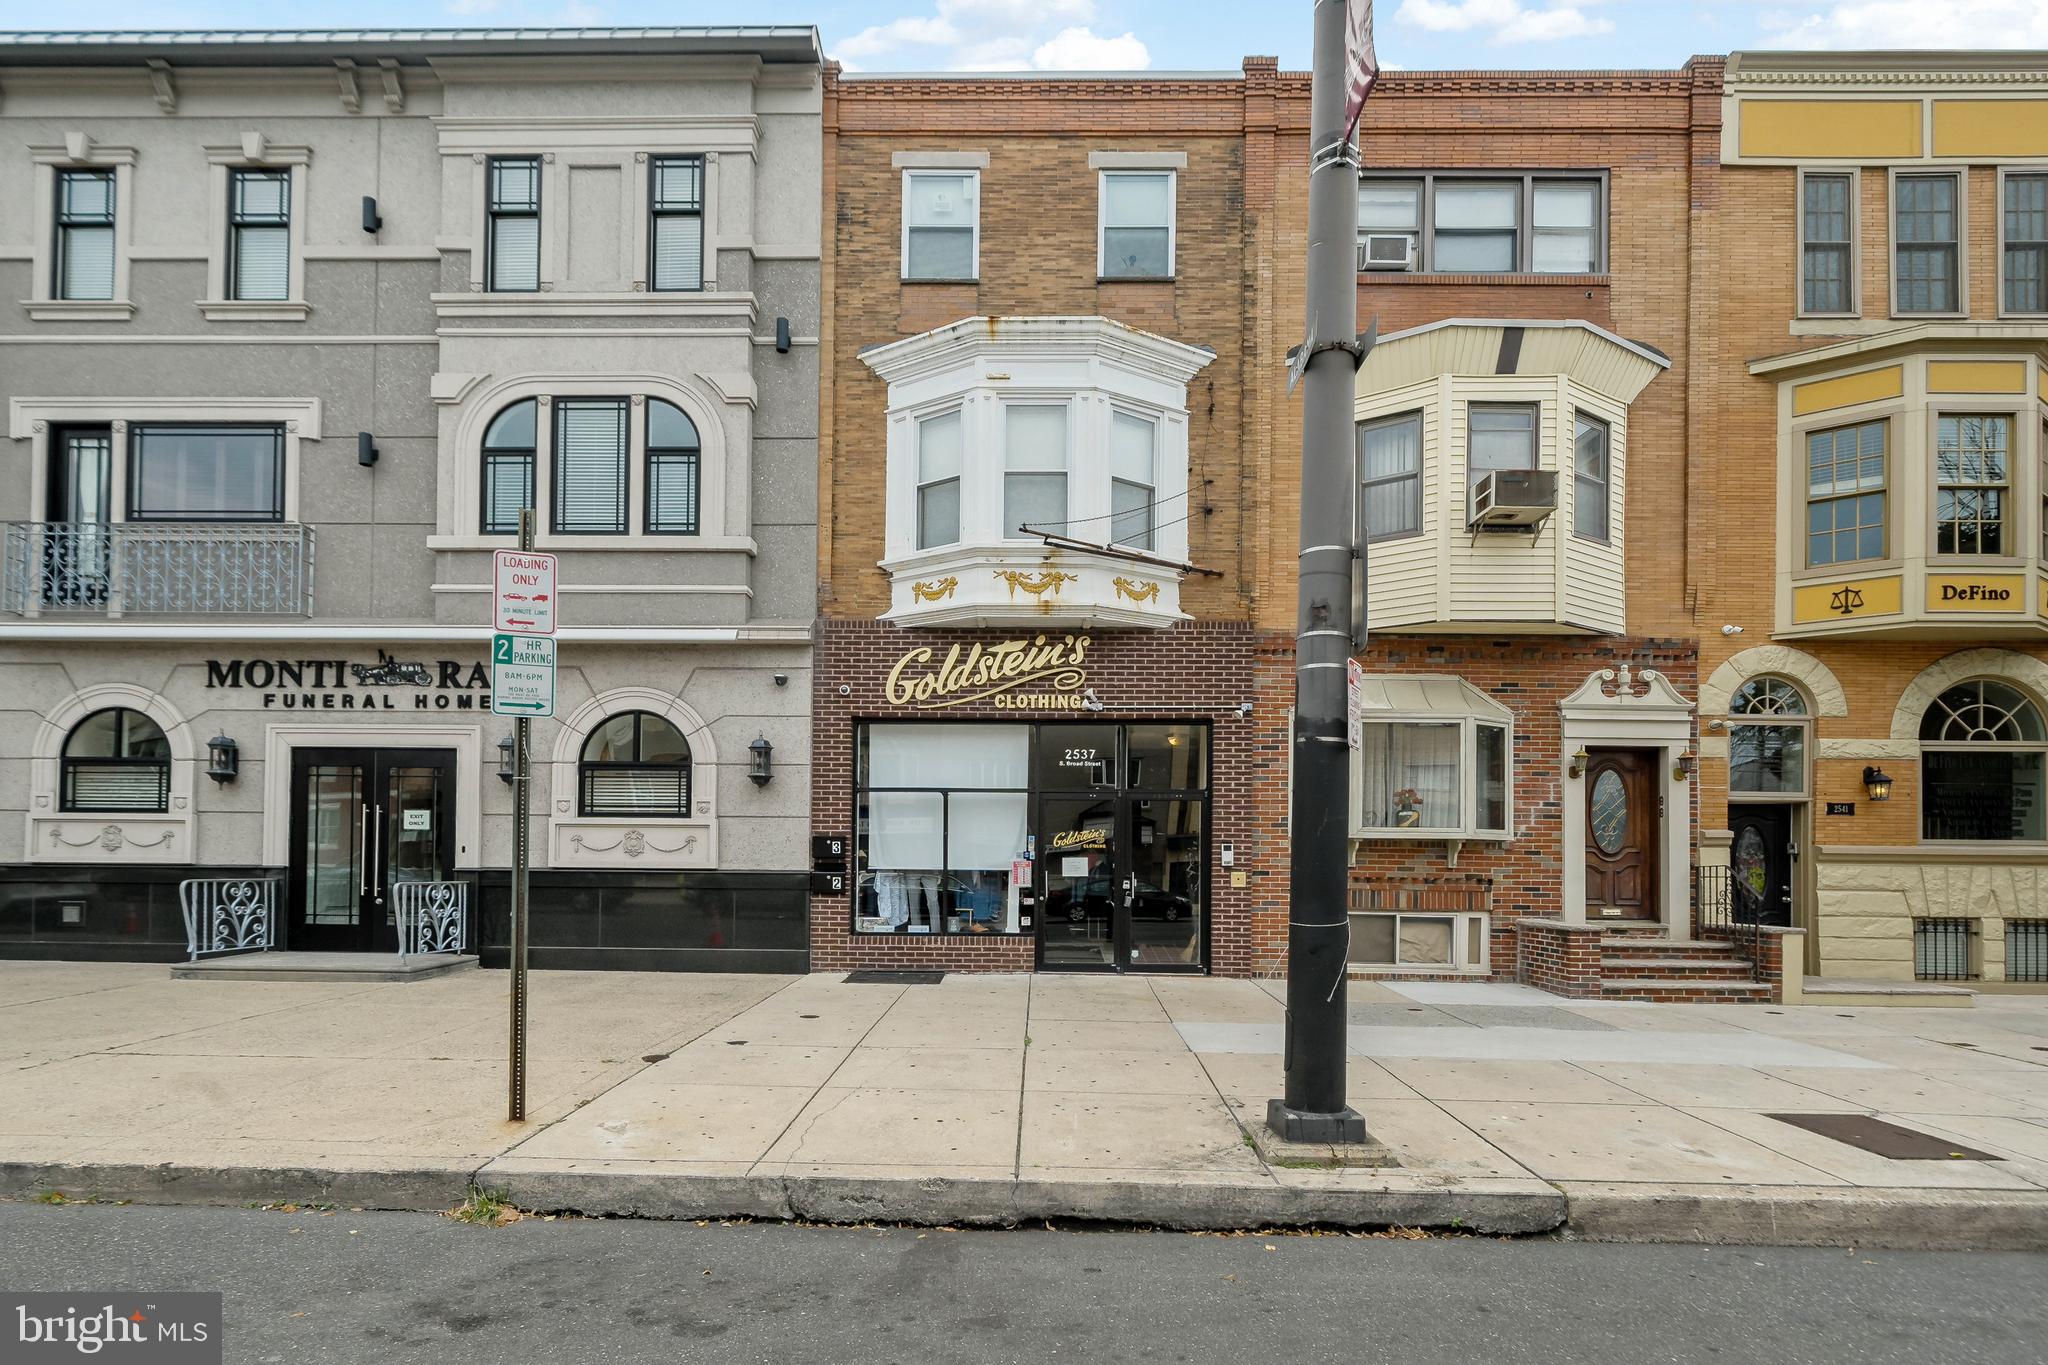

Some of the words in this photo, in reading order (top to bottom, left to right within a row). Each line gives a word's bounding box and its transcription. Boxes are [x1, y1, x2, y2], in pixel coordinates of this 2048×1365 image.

[503, 556, 549, 571] LOADING
[512, 574, 539, 586] ONLY
[1941, 584, 2010, 601] DeFino
[512, 607, 532, 615] MINUTE
[497, 639, 509, 660] 2
[526, 640, 542, 651] HR
[513, 652, 552, 665] PARKING
[205, 659, 348, 688] MONTI
[435, 659, 491, 689] RA
[885, 633, 1091, 706] Goldstein's
[263, 693, 395, 709] FUNERAL
[414, 693, 491, 710] HOME
[994, 693, 1082, 709] CLOTHING
[1064, 748, 1096, 760] 2537
[1834, 804, 1848, 813] 2541
[1053, 828, 1106, 848] Goldstein's
[833, 842, 840, 853] 3
[833, 878, 840, 889] 2
